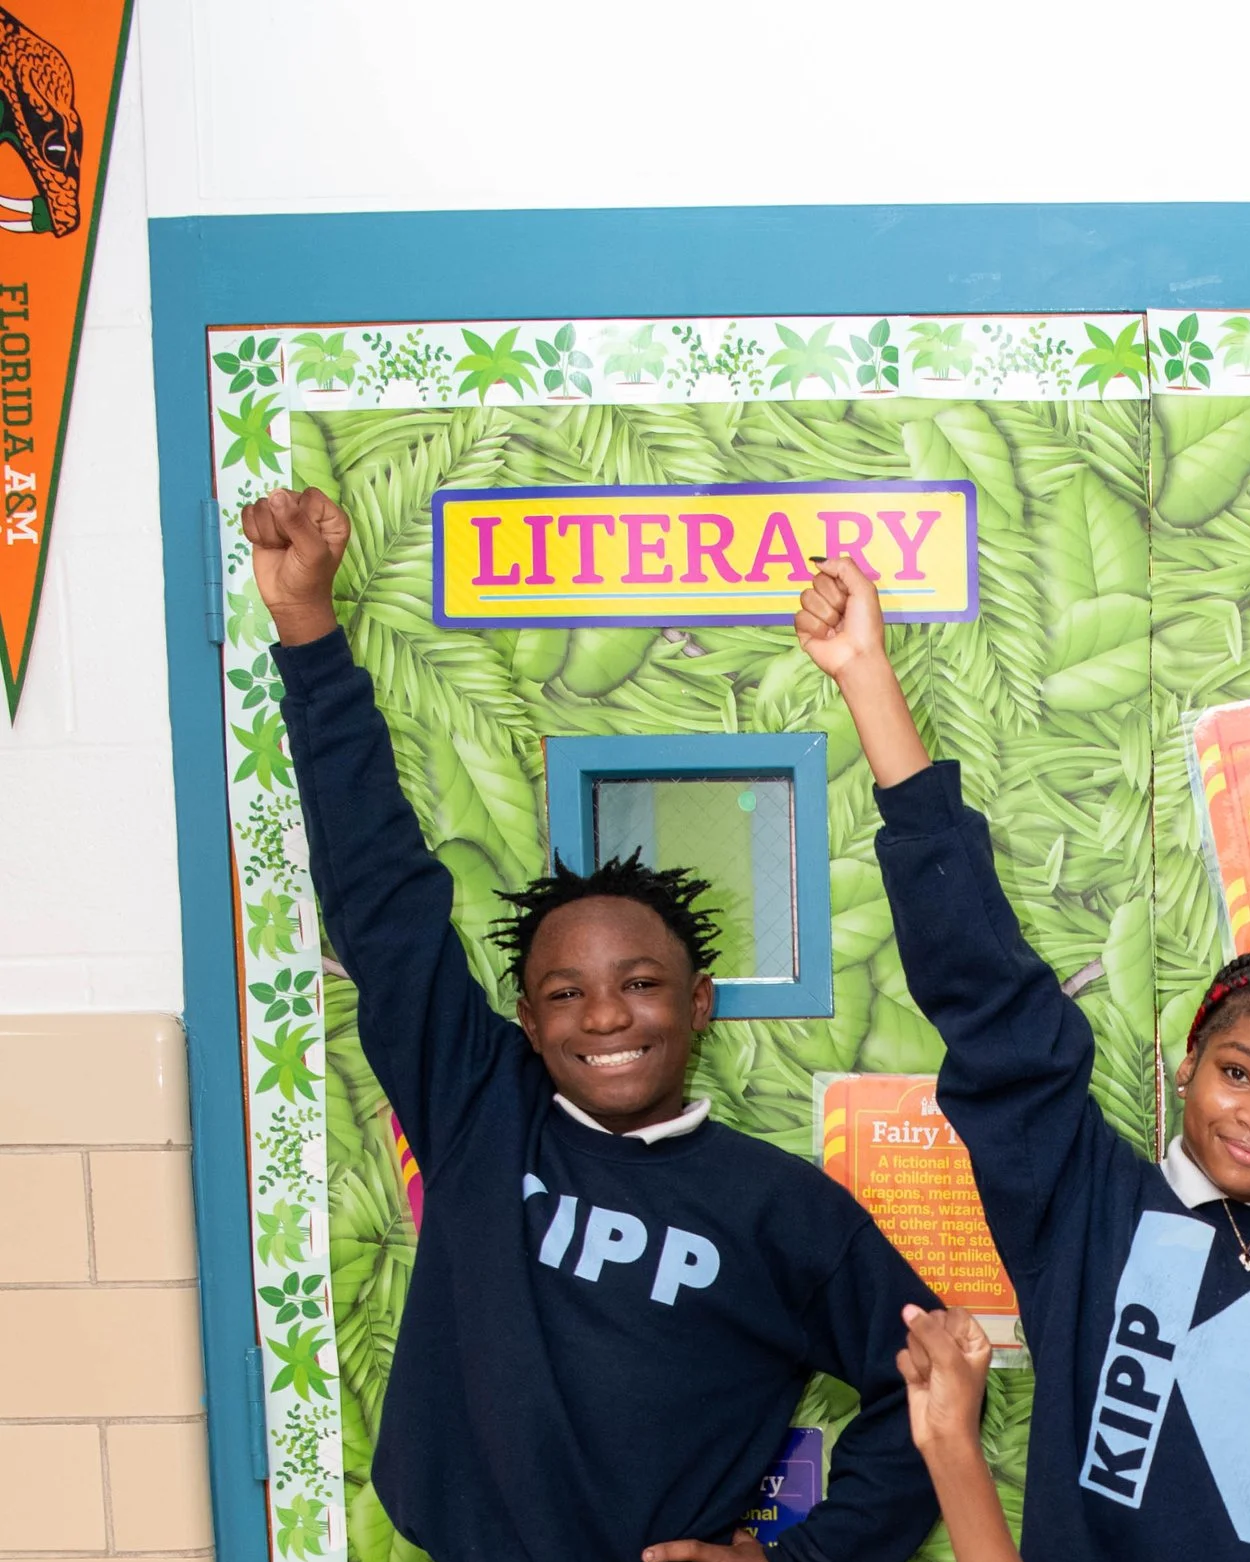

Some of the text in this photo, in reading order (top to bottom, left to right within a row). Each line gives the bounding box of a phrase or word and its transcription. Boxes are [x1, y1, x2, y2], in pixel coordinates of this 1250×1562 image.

[0, 281, 38, 545] FLORIDA A&M
[470, 510, 942, 586] LITERARY
[872, 1120, 940, 1150] Fairy
[878, 1155, 889, 1169] A
[892, 1155, 950, 1169] fictional
[870, 1170, 891, 1184] for
[894, 1170, 951, 1185] children
[862, 1185, 980, 1202] dragons, merma
[869, 1203, 935, 1217] unicorns,
[876, 1217, 989, 1234] nd other magic
[523, 1173, 720, 1306] IPP
[938, 1232, 966, 1246] The
[969, 1235, 994, 1247] sto
[927, 1250, 945, 1261] on
[950, 1248, 1001, 1265] unlikely
[919, 1263, 999, 1280] and usually
[954, 1280, 1007, 1296] ending.
[1087, 1303, 1177, 1499] KIPP
